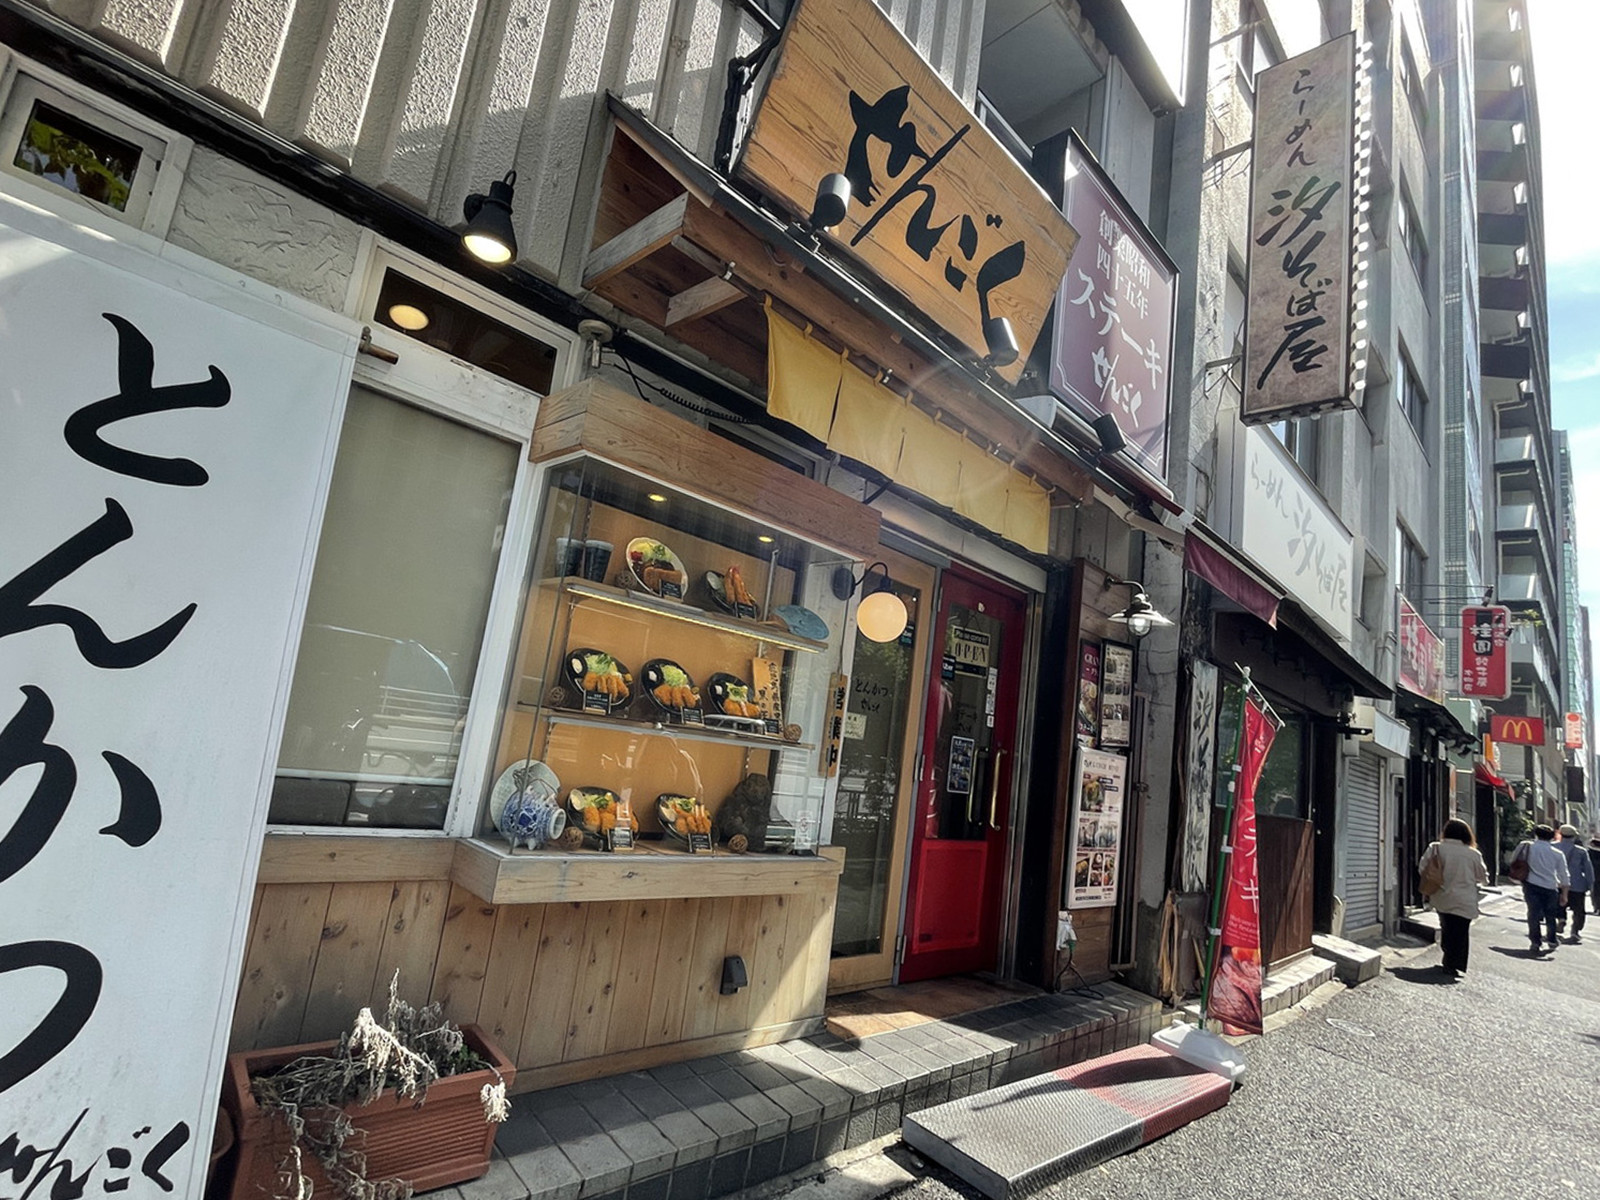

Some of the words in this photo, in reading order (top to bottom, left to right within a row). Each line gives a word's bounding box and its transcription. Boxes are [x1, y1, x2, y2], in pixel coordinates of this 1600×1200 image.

[1287, 69, 1317, 168] らーめん
[843, 85, 1026, 358] せんごく
[1098, 208, 1151, 291] 創業昭和
[1096, 243, 1149, 320] 四十五年
[1070, 267, 1163, 391] ステーキ
[1091, 345, 1142, 429] せんごく
[855, 678, 889, 698] とんかつ
[955, 642, 986, 663] OPEN
[827, 686, 846, 768] 営業中
